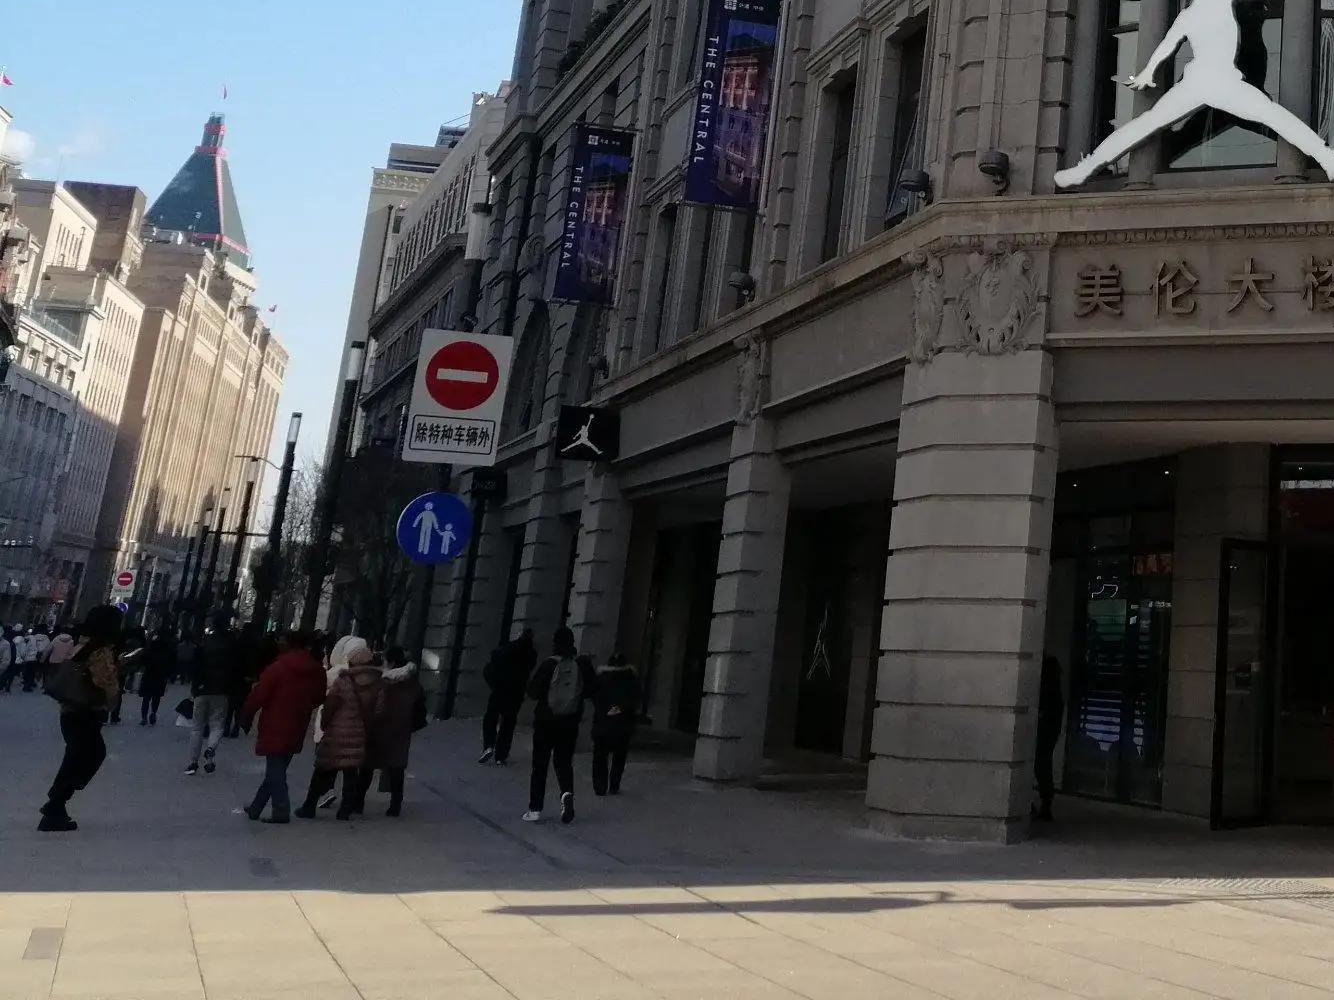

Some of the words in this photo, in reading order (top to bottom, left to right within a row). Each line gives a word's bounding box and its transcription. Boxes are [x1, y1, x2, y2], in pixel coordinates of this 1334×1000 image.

[705, 35, 719, 69] THE
[693, 79, 714, 164] CENTRAL
[572, 166, 584, 193] THE
[561, 200, 579, 269] CENTRAL
[414, 421, 490, 448] 除特种车辆外
